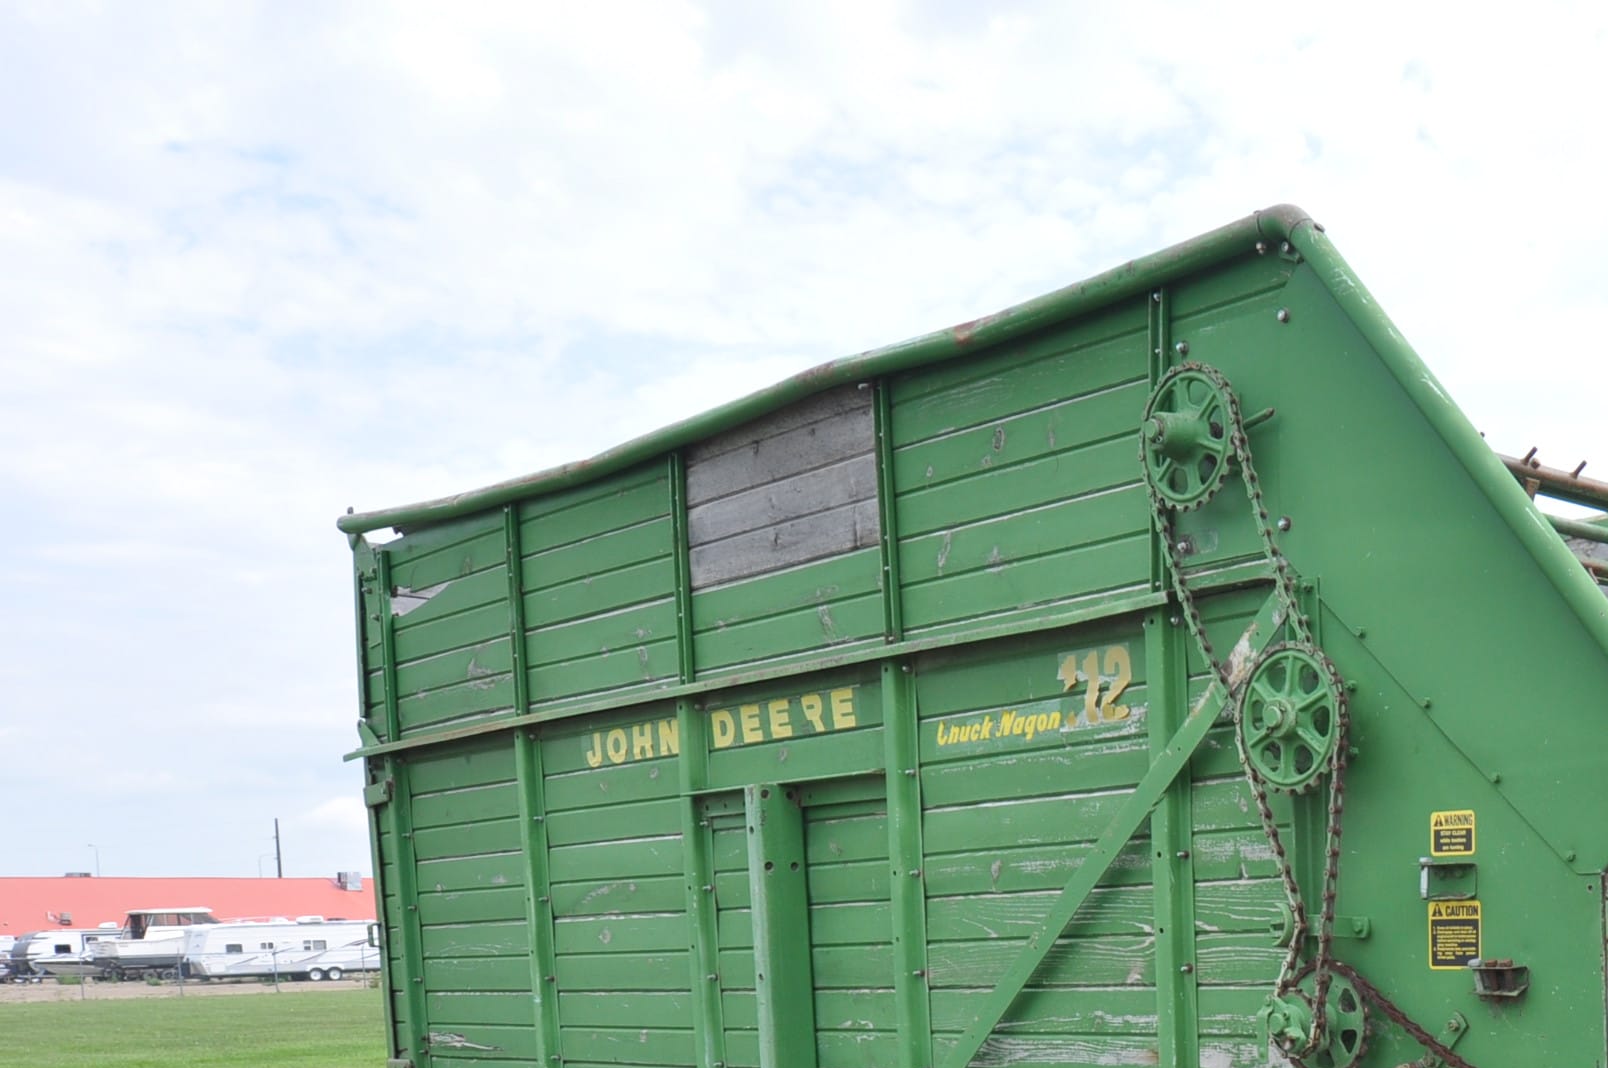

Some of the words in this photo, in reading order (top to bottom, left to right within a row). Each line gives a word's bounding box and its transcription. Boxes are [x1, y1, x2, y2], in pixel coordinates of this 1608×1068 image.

[586, 716, 679, 768] JOHN
[710, 687, 857, 748] DEERE
[1443, 814, 1473, 827] WARNING
[1445, 904, 1479, 917] CAUTION
